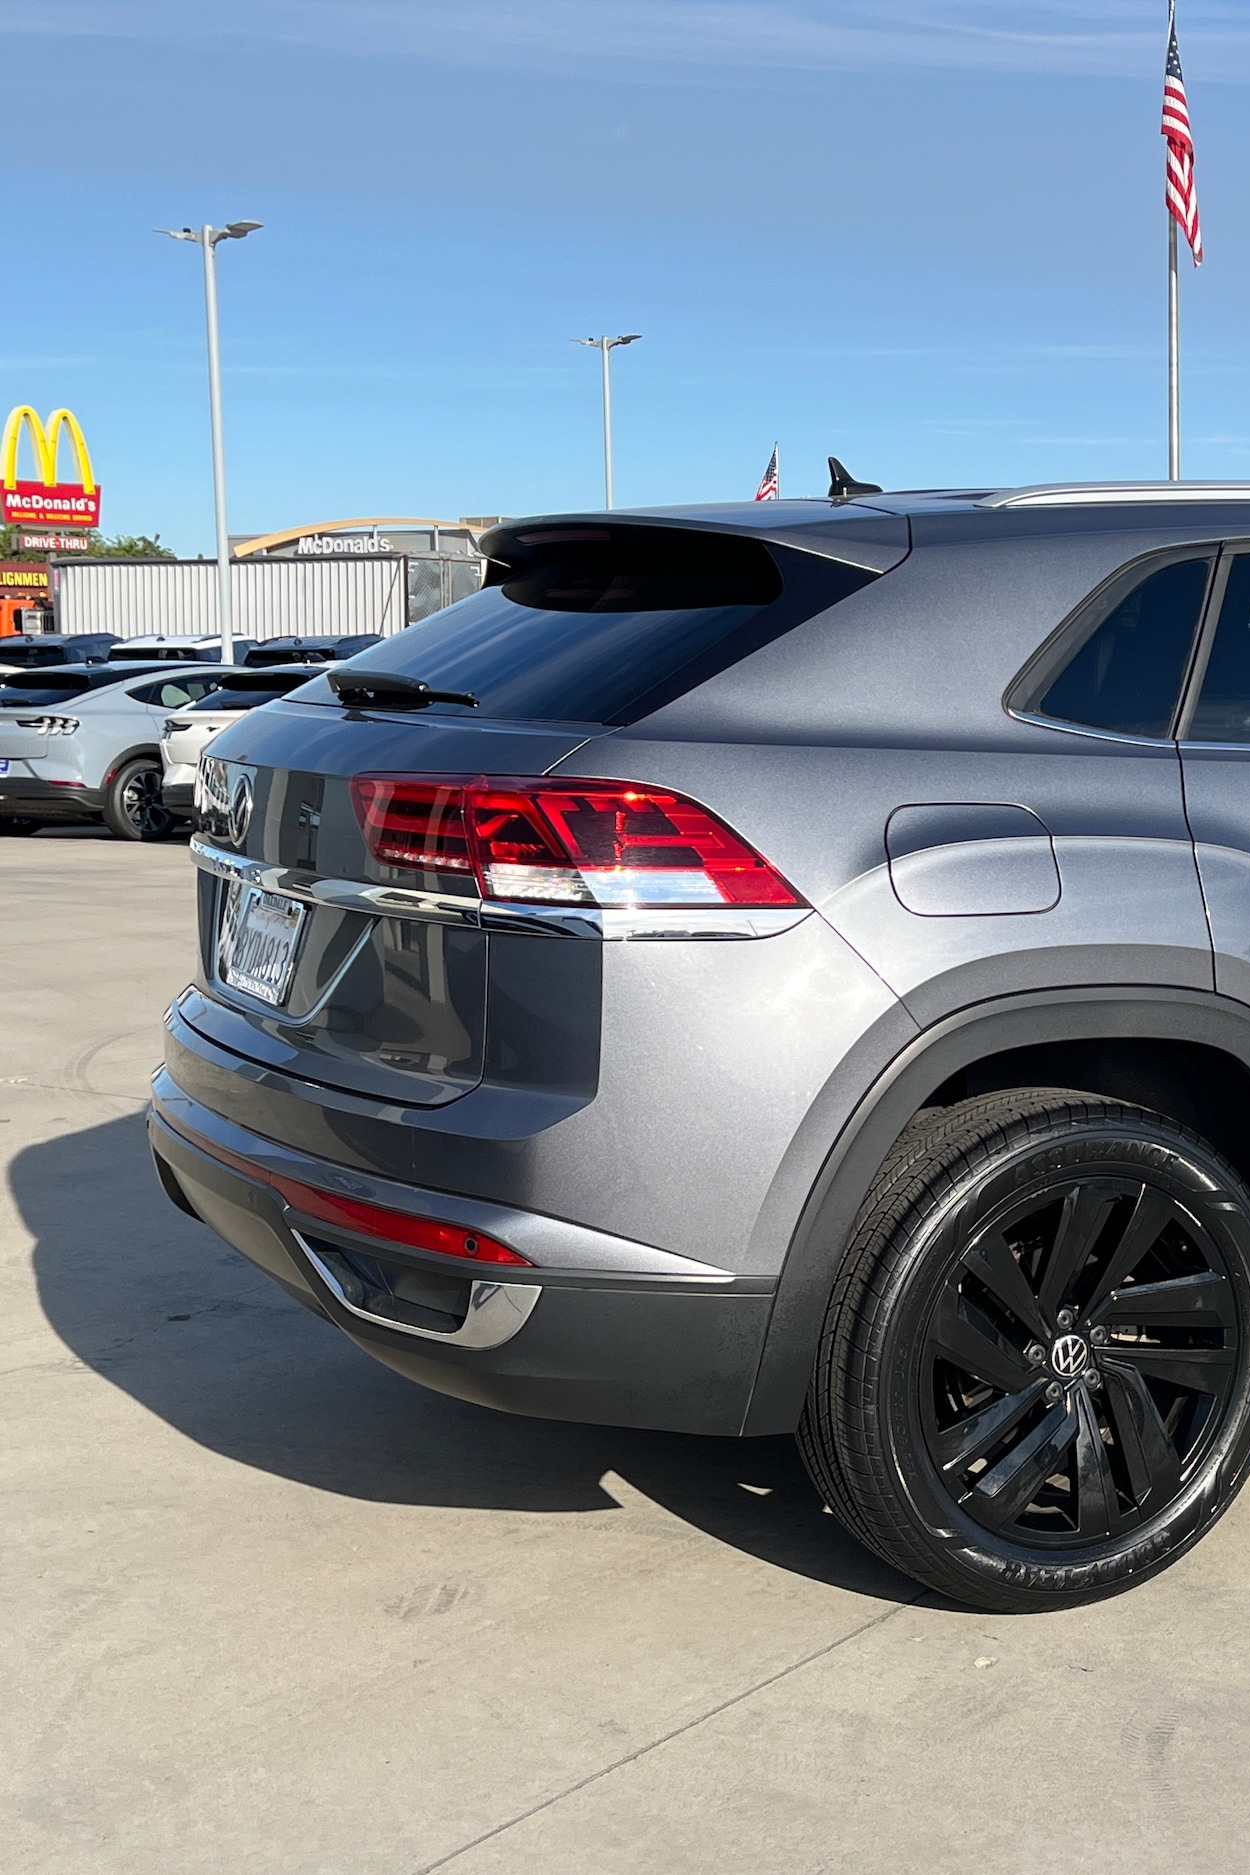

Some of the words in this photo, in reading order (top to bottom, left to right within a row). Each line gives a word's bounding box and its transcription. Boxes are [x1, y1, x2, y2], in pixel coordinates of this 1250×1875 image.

[5, 493, 96, 512] McDonald's
[24, 536, 88, 550] DRIVE-THRU
[297, 536, 391, 554] McDonald's
[235, 928, 290, 986] 8YDA813
